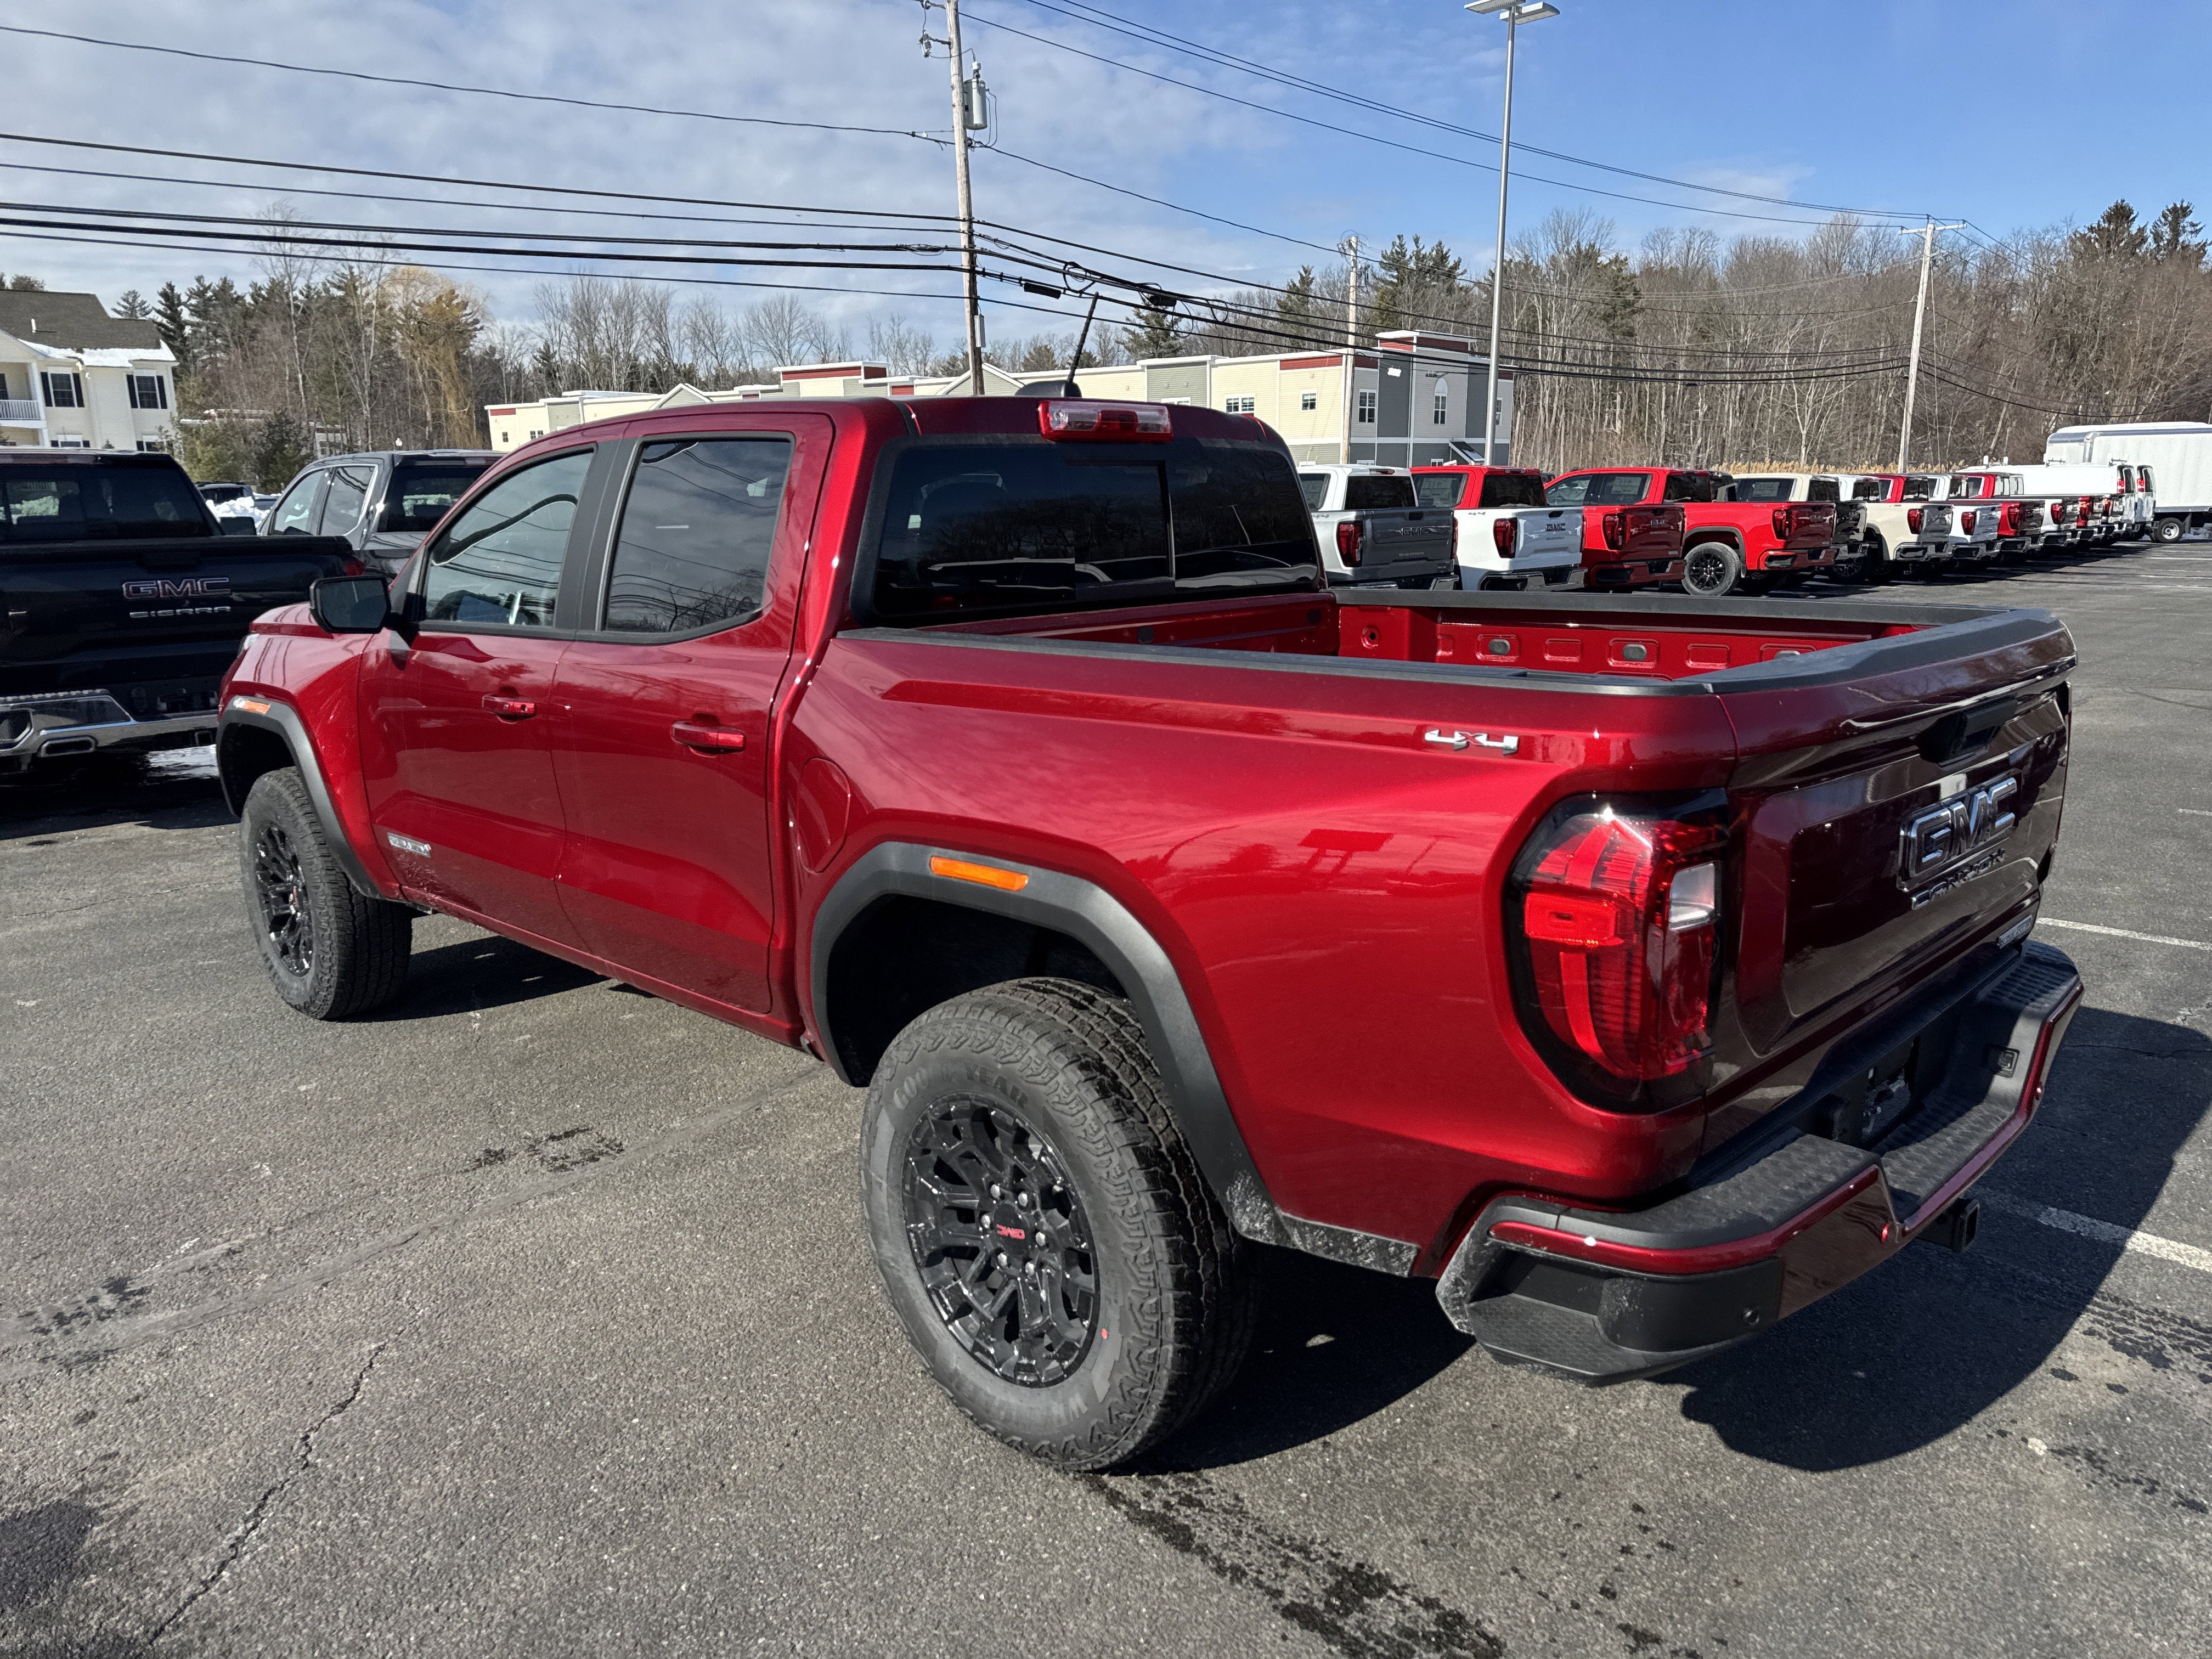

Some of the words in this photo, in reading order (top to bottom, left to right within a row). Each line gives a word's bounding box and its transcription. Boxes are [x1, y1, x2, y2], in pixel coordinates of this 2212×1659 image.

[1401, 527, 1429, 536] GMC
[1545, 523, 1566, 532] GMC
[122, 577, 231, 600] GMC
[129, 606, 232, 618] SIERRA
[1425, 729, 1519, 755] 4X4
[1898, 771, 2021, 888] GMC
[1910, 848, 2005, 910] CANYON
